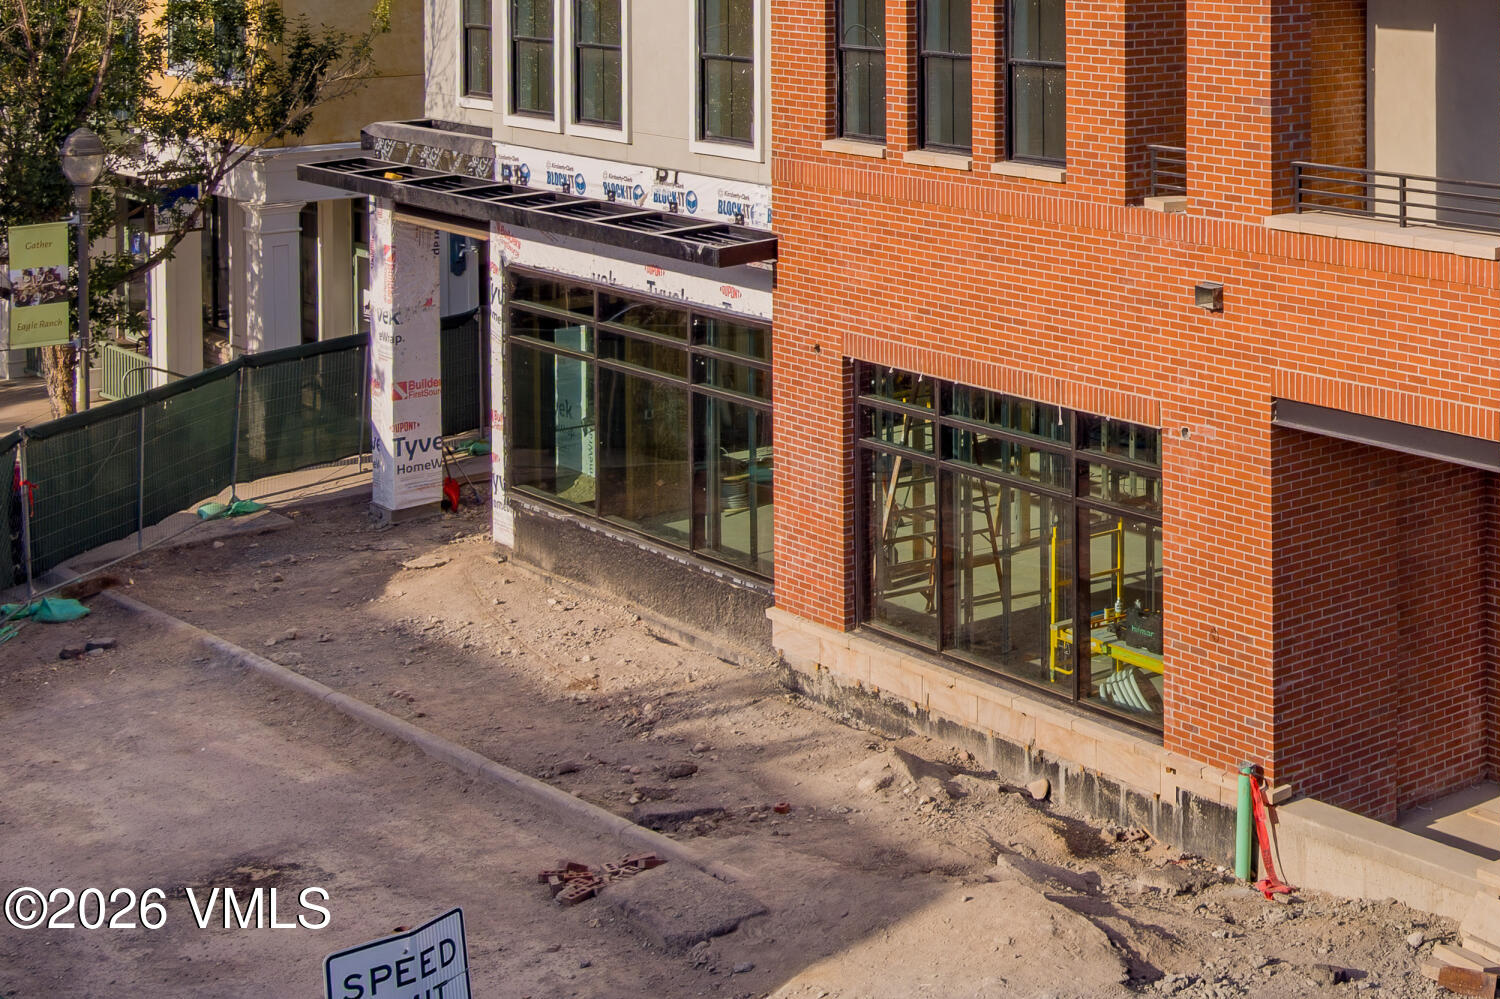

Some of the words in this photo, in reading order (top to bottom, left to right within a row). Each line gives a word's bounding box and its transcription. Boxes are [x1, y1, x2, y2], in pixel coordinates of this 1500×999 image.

[25, 240, 53, 250] Gather
[720, 285, 742, 299] DUPONT
[17, 321, 38, 333] Eagle
[39, 319, 63, 330] Ranch
[343, 938, 456, 999] SPEED
